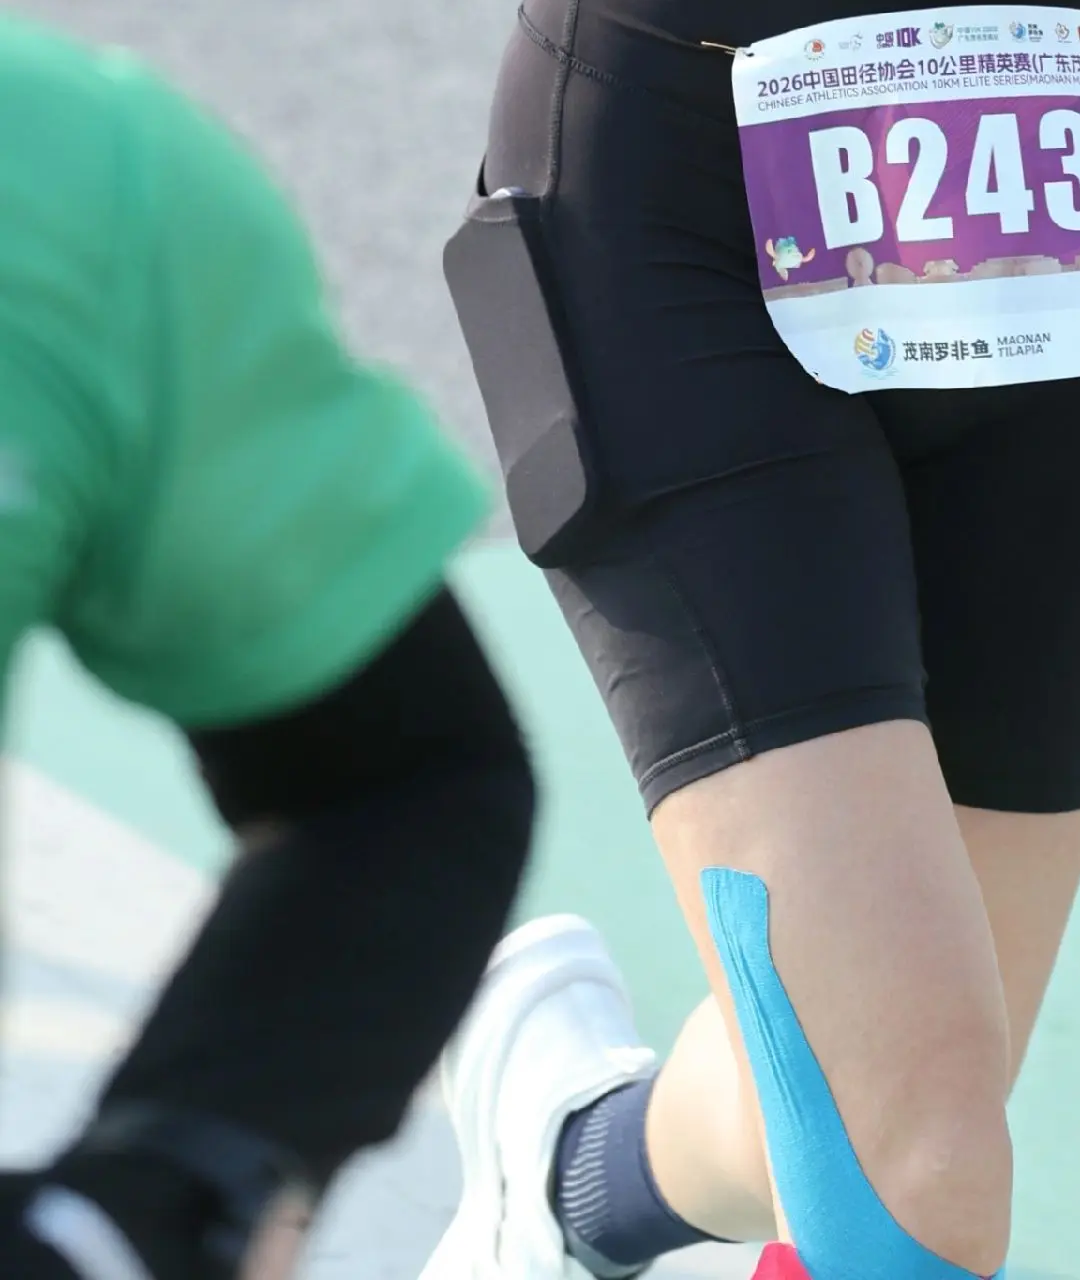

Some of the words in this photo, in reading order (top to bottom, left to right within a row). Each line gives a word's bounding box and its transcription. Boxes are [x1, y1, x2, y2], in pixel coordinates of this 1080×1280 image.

[757, 95, 804, 112] CHINESE
[805, 87, 860, 104] ATHLETICS
[860, 80, 928, 98] ASSOCIATION
[932, 79, 960, 90] 10KM
[963, 76, 990, 88] ELITE
[997, 332, 1052, 346] MAONAN
[902, 338, 994, 362] 茂南罗非鱼
[997, 343, 1045, 358] TILAPIA
